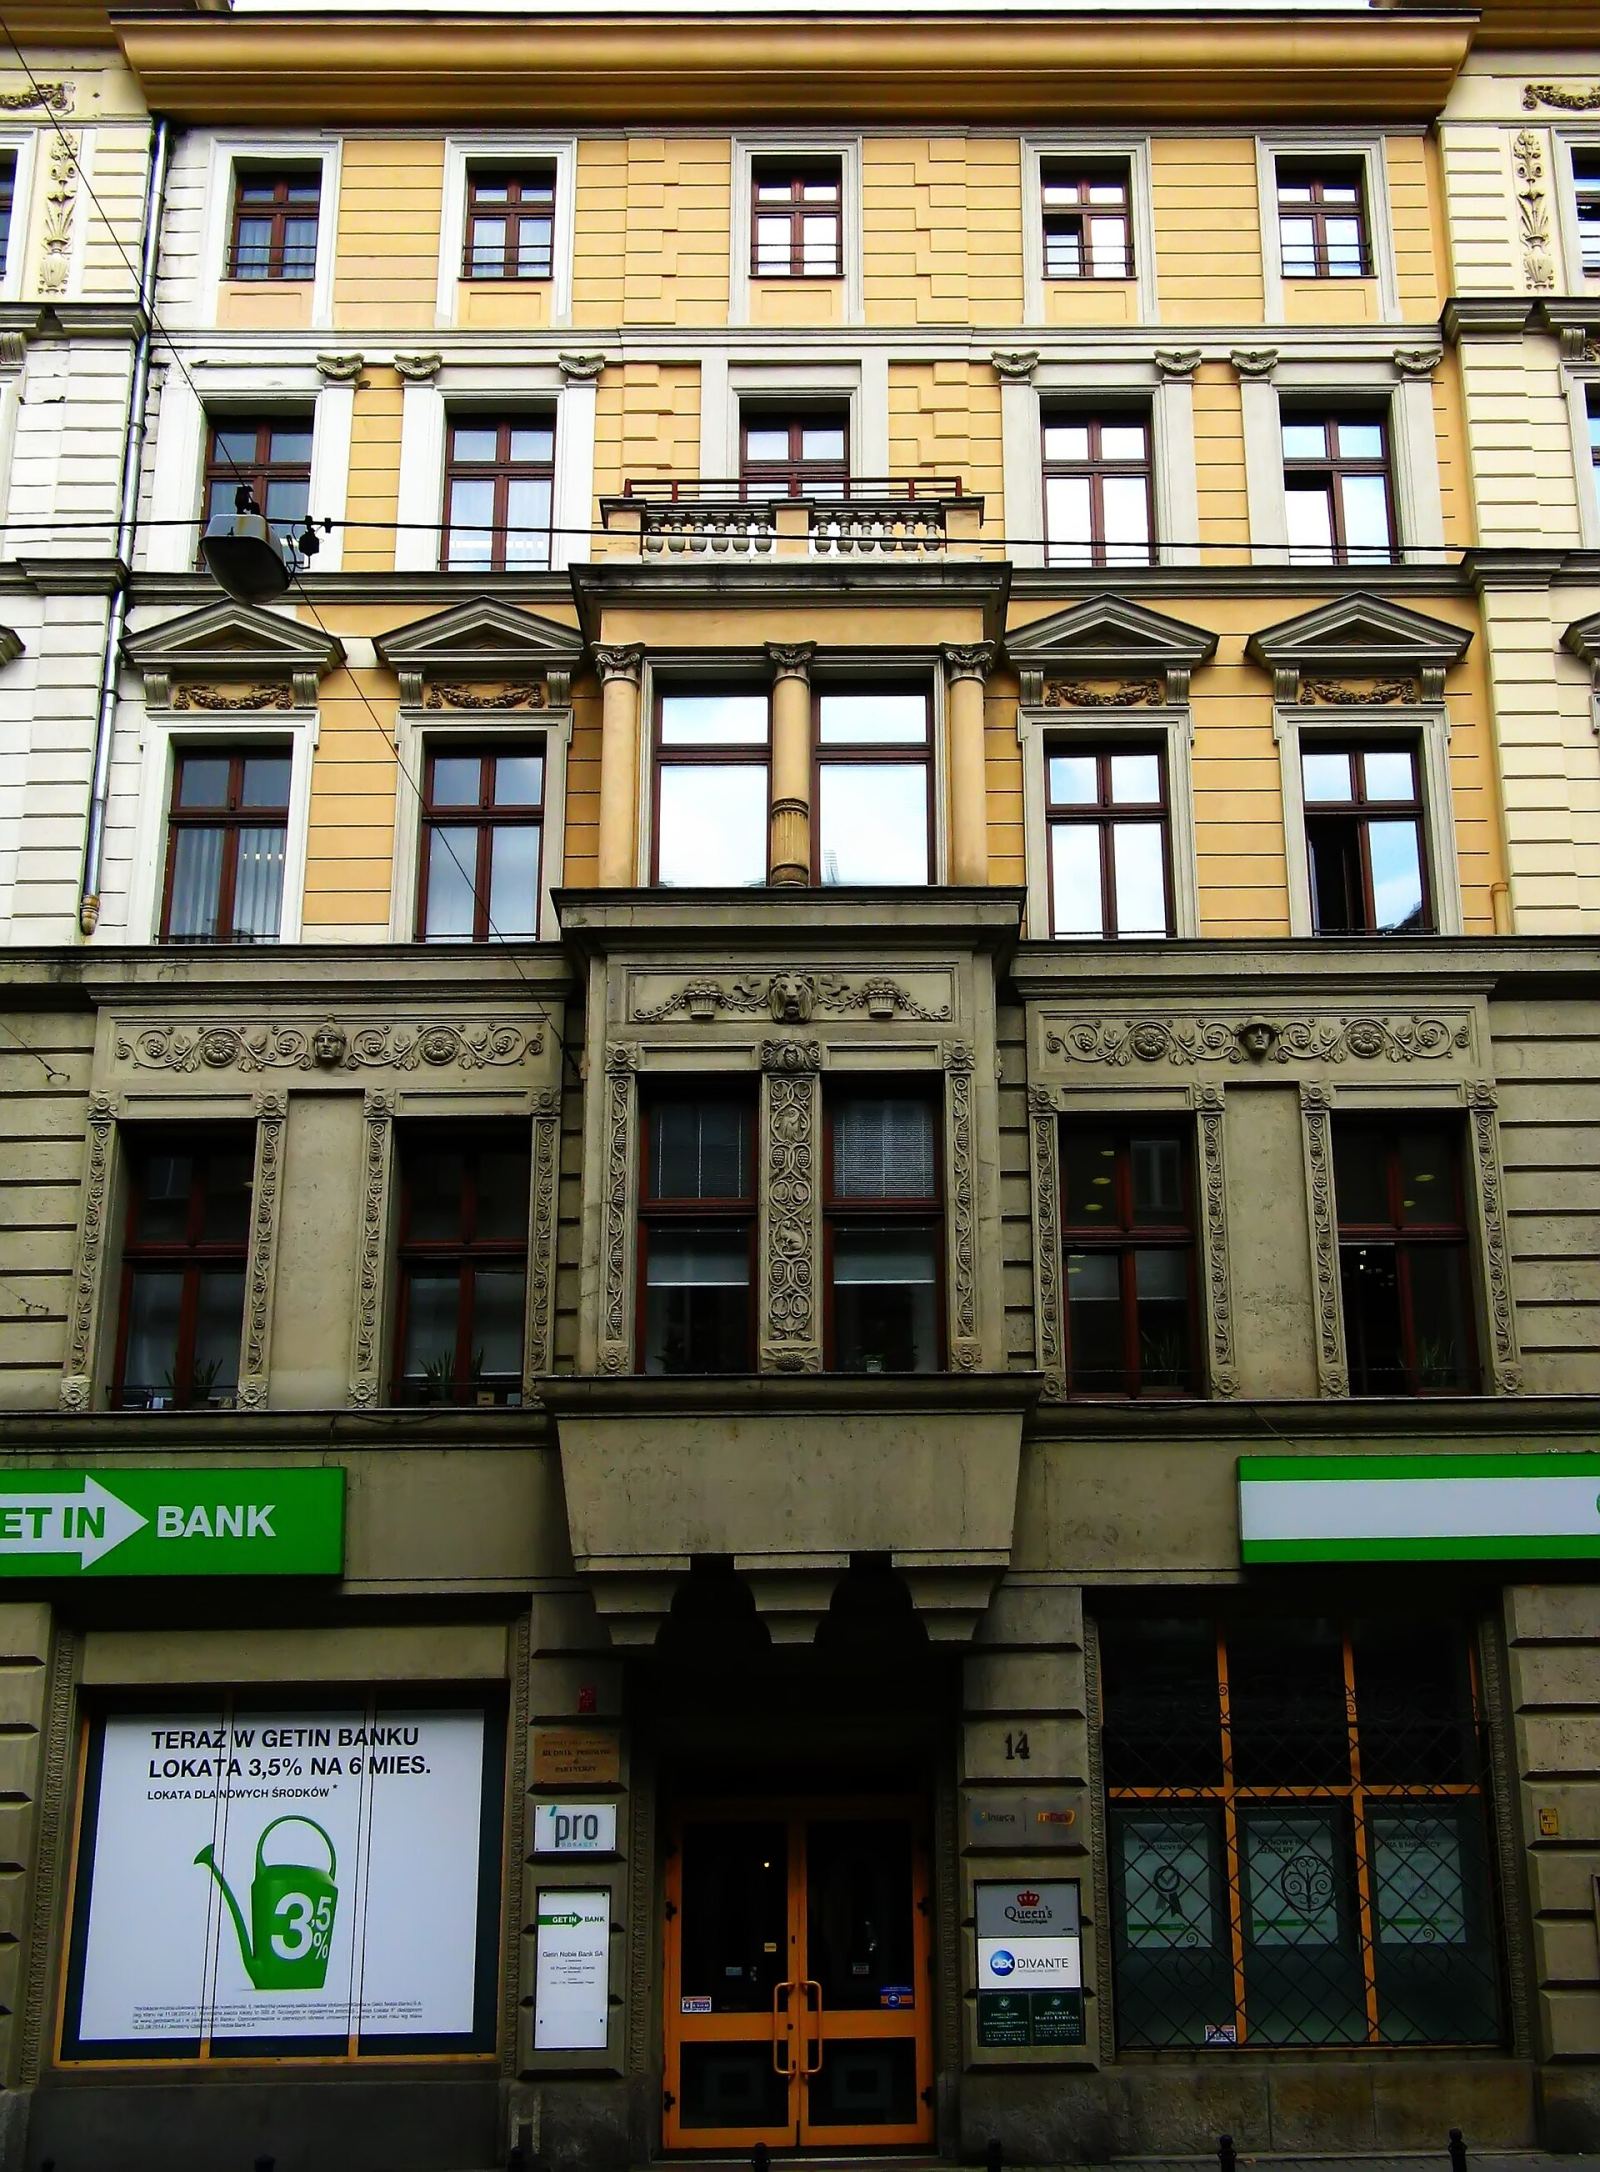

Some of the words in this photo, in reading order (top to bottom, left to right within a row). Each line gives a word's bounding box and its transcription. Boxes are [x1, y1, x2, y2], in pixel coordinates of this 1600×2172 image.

[156, 1505, 276, 1538] BANK
[151, 1730, 227, 1749] TERAZ
[233, 1730, 255, 1748] W
[261, 1729, 331, 1748] GETIN
[338, 1727, 420, 1747] BANKU
[1006, 1733, 1029, 1759] 14
[149, 1758, 242, 1778] LOKATA
[248, 1758, 303, 1780] 3,5%
[310, 1757, 343, 1775] NA
[349, 1757, 363, 1774] 6
[368, 1755, 431, 1775] MIES.
[147, 1789, 192, 1800] LOKATA
[194, 1788, 217, 1800] DLA
[219, 1787, 269, 1799] NOWYCH
[271, 1785, 330, 1799] ŚRODKÓW
[1004, 1905, 1052, 1923] Queen's
[1017, 1958, 1069, 1968] DIVANTE
